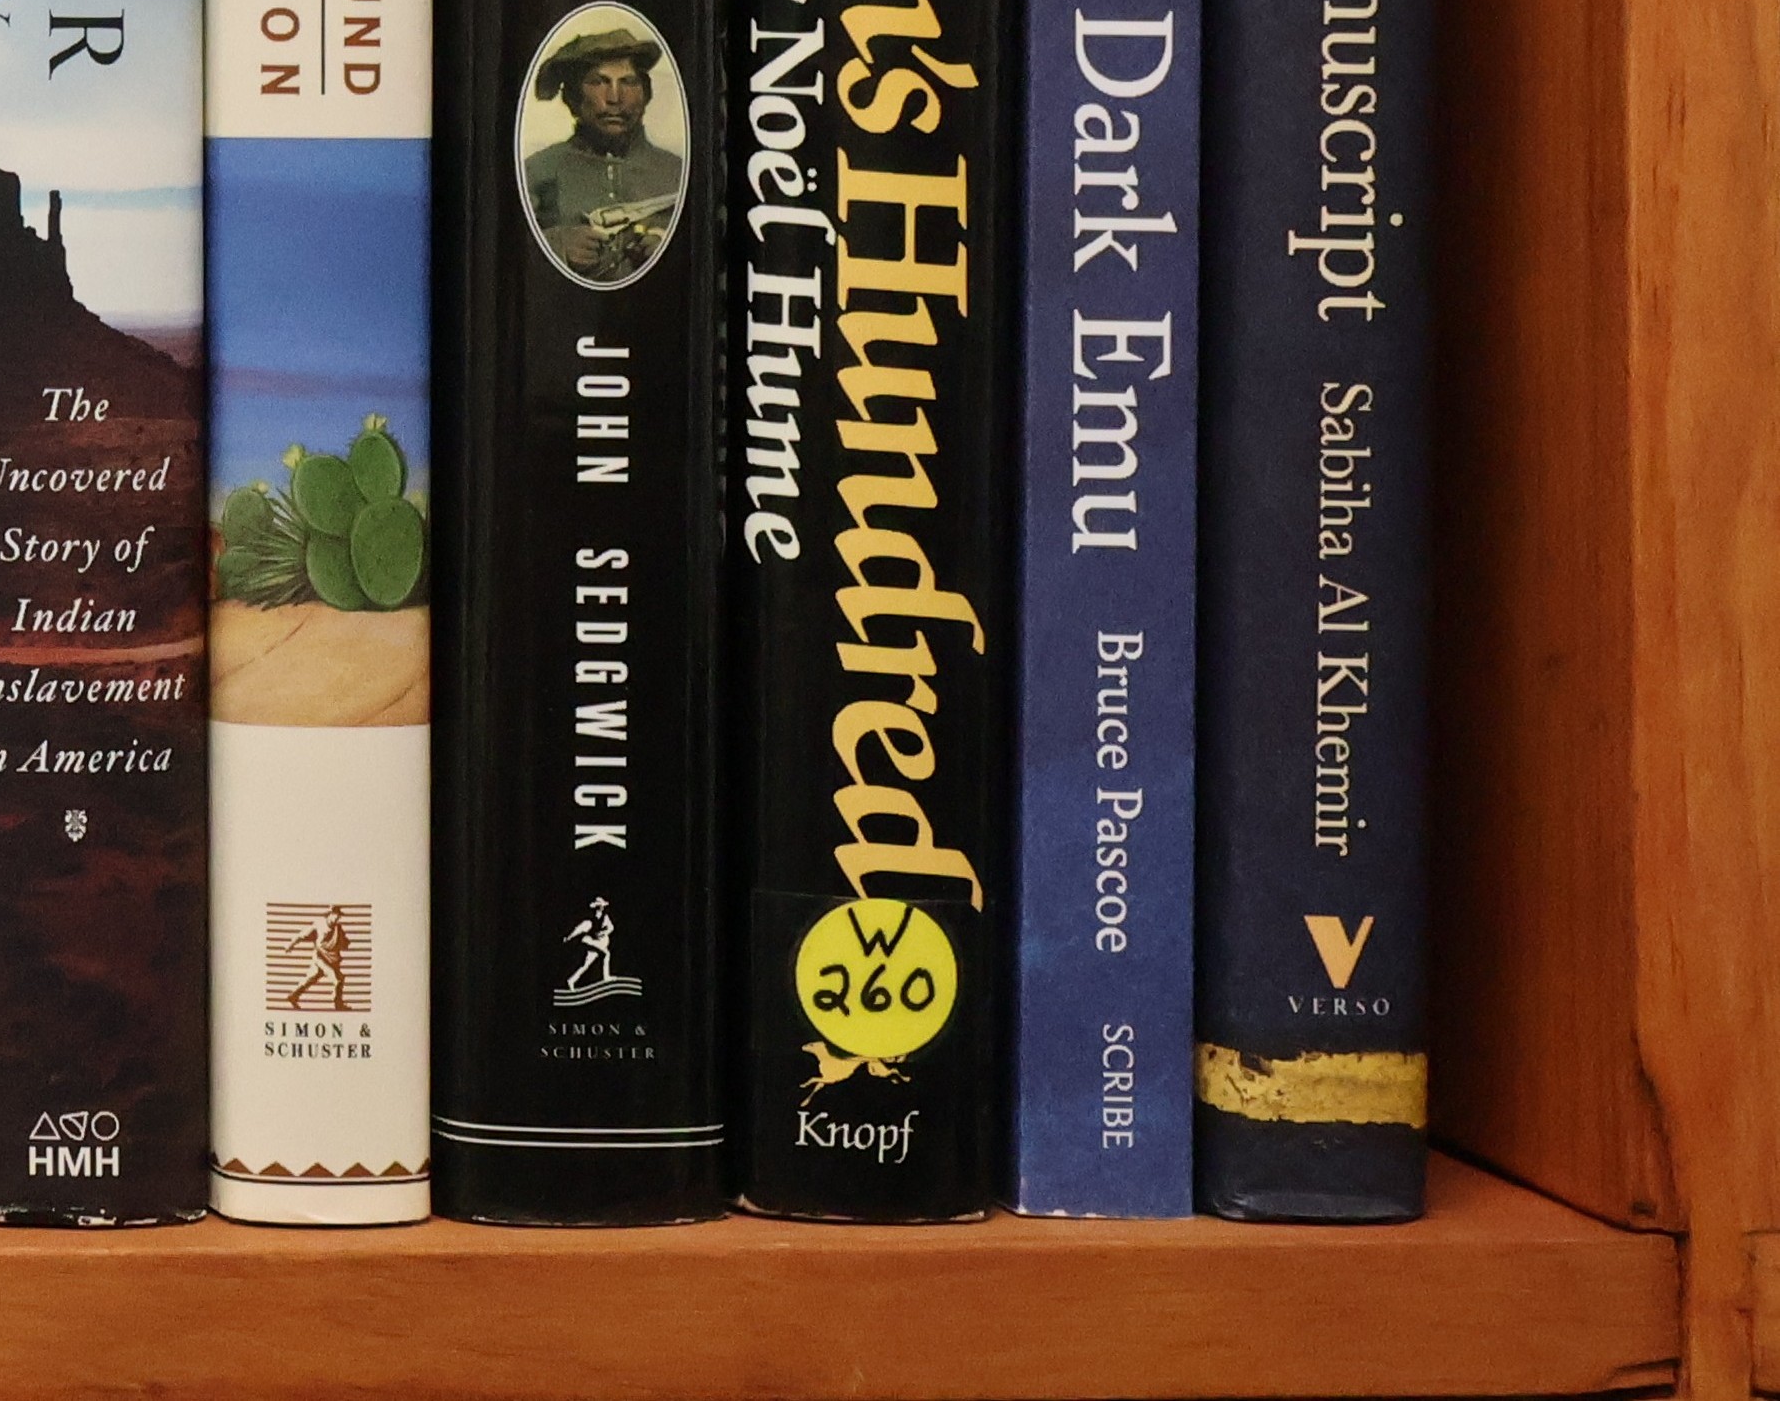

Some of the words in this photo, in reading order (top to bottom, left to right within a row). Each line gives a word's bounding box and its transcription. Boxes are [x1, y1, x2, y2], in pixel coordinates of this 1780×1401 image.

[748, 18, 836, 245] Noël
[1074, 8, 1177, 272] Dark
[43, 387, 109, 421] The
[577, 336, 630, 482] JOHN
[744, 262, 821, 564] Hume
[1072, 309, 1171, 554] Emu
[1319, 383, 1372, 559] Sabiha
[0, 528, 100, 573] Story
[115, 526, 155, 569] of
[832, 148, 984, 913] Hundred
[11, 598, 135, 632] Indian
[1318, 574, 1369, 634] Al
[575, 549, 629, 849] SEDGWICK
[1097, 631, 1143, 769] Bruce
[16, 739, 171, 773] America
[1316, 651, 1368, 856] Khemir
[1096, 787, 1142, 952] Pascoe
[848, 906, 914, 958] W
[265, 1022, 342, 1038] SIMON
[360, 1023, 371, 1038] &
[813, 964, 935, 1016] 260
[1288, 996, 1389, 1015] VERSO
[265, 1043, 371, 1058] SCHUSTER
[1103, 1024, 1134, 1148] SCRIBE
[29, 1146, 119, 1177] HMH
[795, 1111, 919, 1163] Knopf
